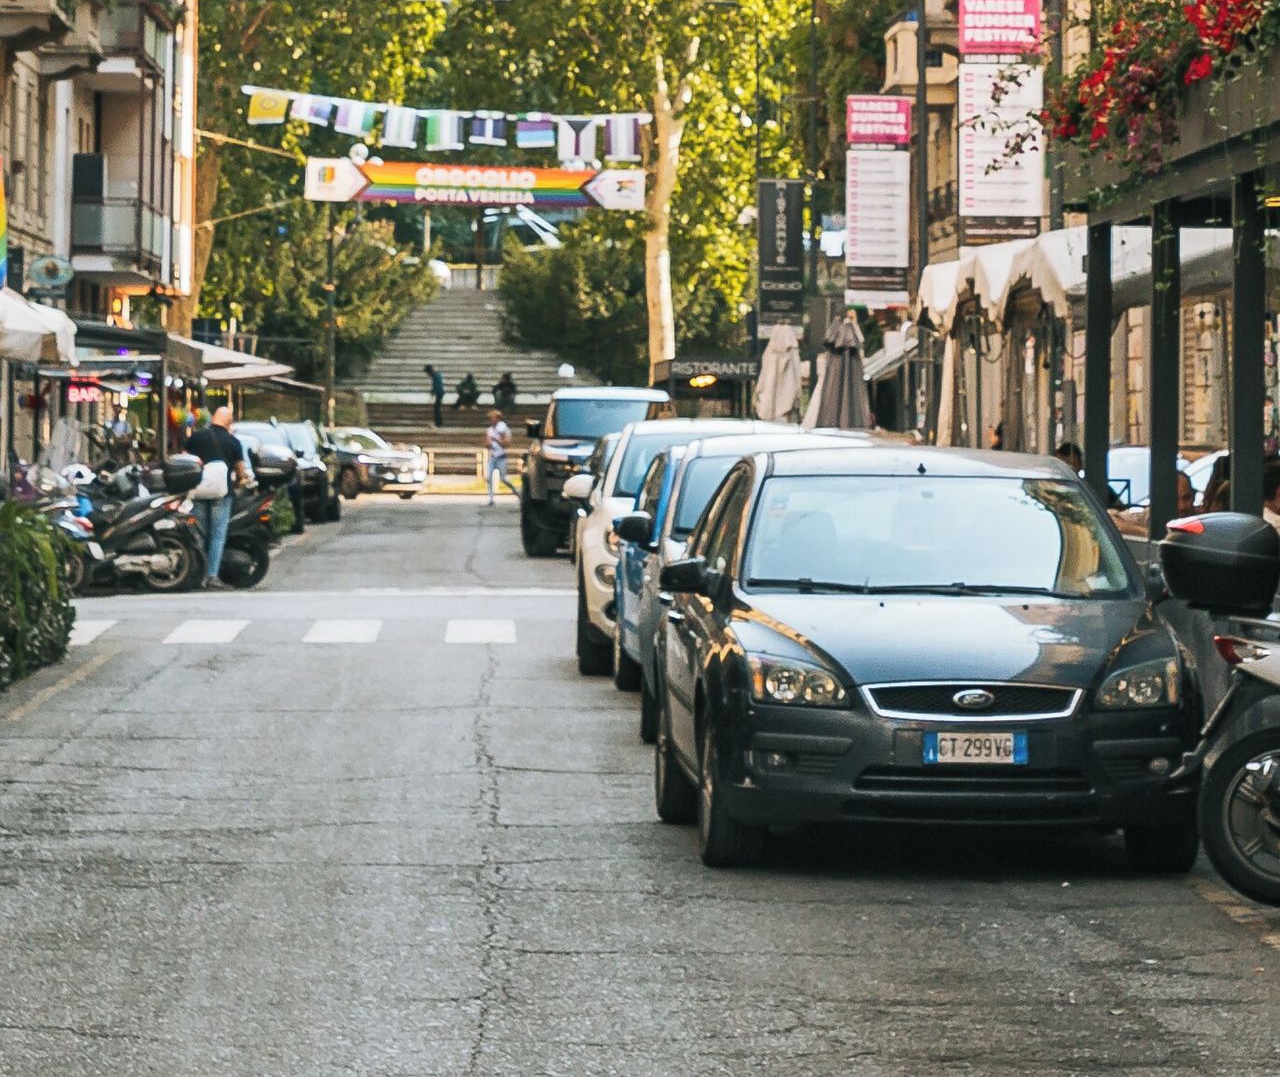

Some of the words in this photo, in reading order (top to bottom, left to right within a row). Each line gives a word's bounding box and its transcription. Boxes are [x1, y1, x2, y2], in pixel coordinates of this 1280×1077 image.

[964, 0, 1025, 12] VARESE
[964, 14, 1035, 27] SUMMER
[415, 167, 537, 189] ORGOGLIO
[415, 188, 468, 202] PORTA
[468, 190, 535, 204] VENEZIA
[671, 362, 758, 376] RISTORANTE
